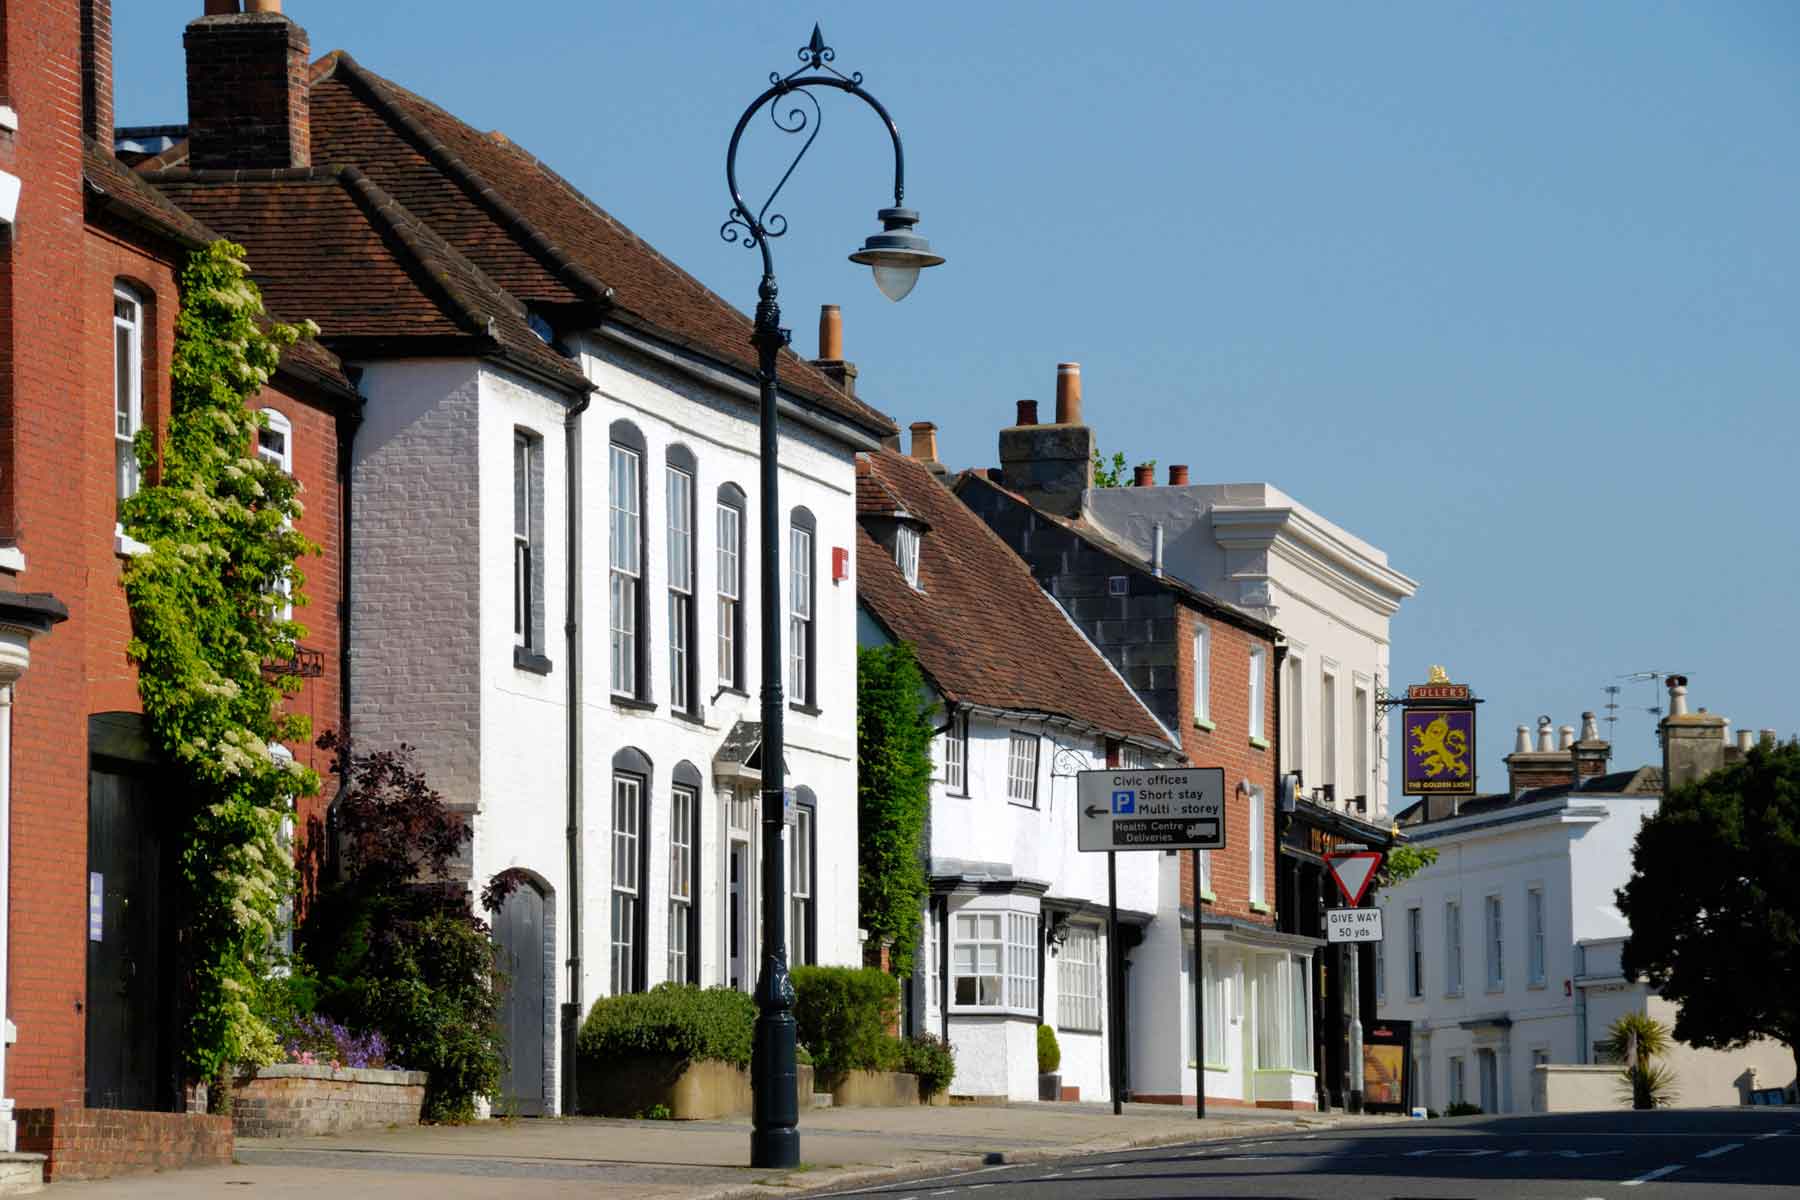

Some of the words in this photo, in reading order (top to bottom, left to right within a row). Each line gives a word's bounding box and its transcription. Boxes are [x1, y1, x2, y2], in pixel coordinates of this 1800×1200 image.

[1113, 776, 1142, 786] Civic
[1147, 774, 1188, 785] offices
[1139, 789, 1173, 800] Short
[1178, 789, 1203, 801] stay
[1117, 793, 1130, 811] P
[1139, 804, 1170, 815] Multi
[1181, 804, 1219, 816] storey
[1115, 822, 1147, 831] Health
[1151, 821, 1184, 831] Centre
[1126, 833, 1173, 842] Deliveries
[1330, 914, 1353, 924] GIVE
[1357, 912, 1378, 923] WAY
[1339, 927, 1351, 937] 50
[1354, 927, 1370, 938] yds
